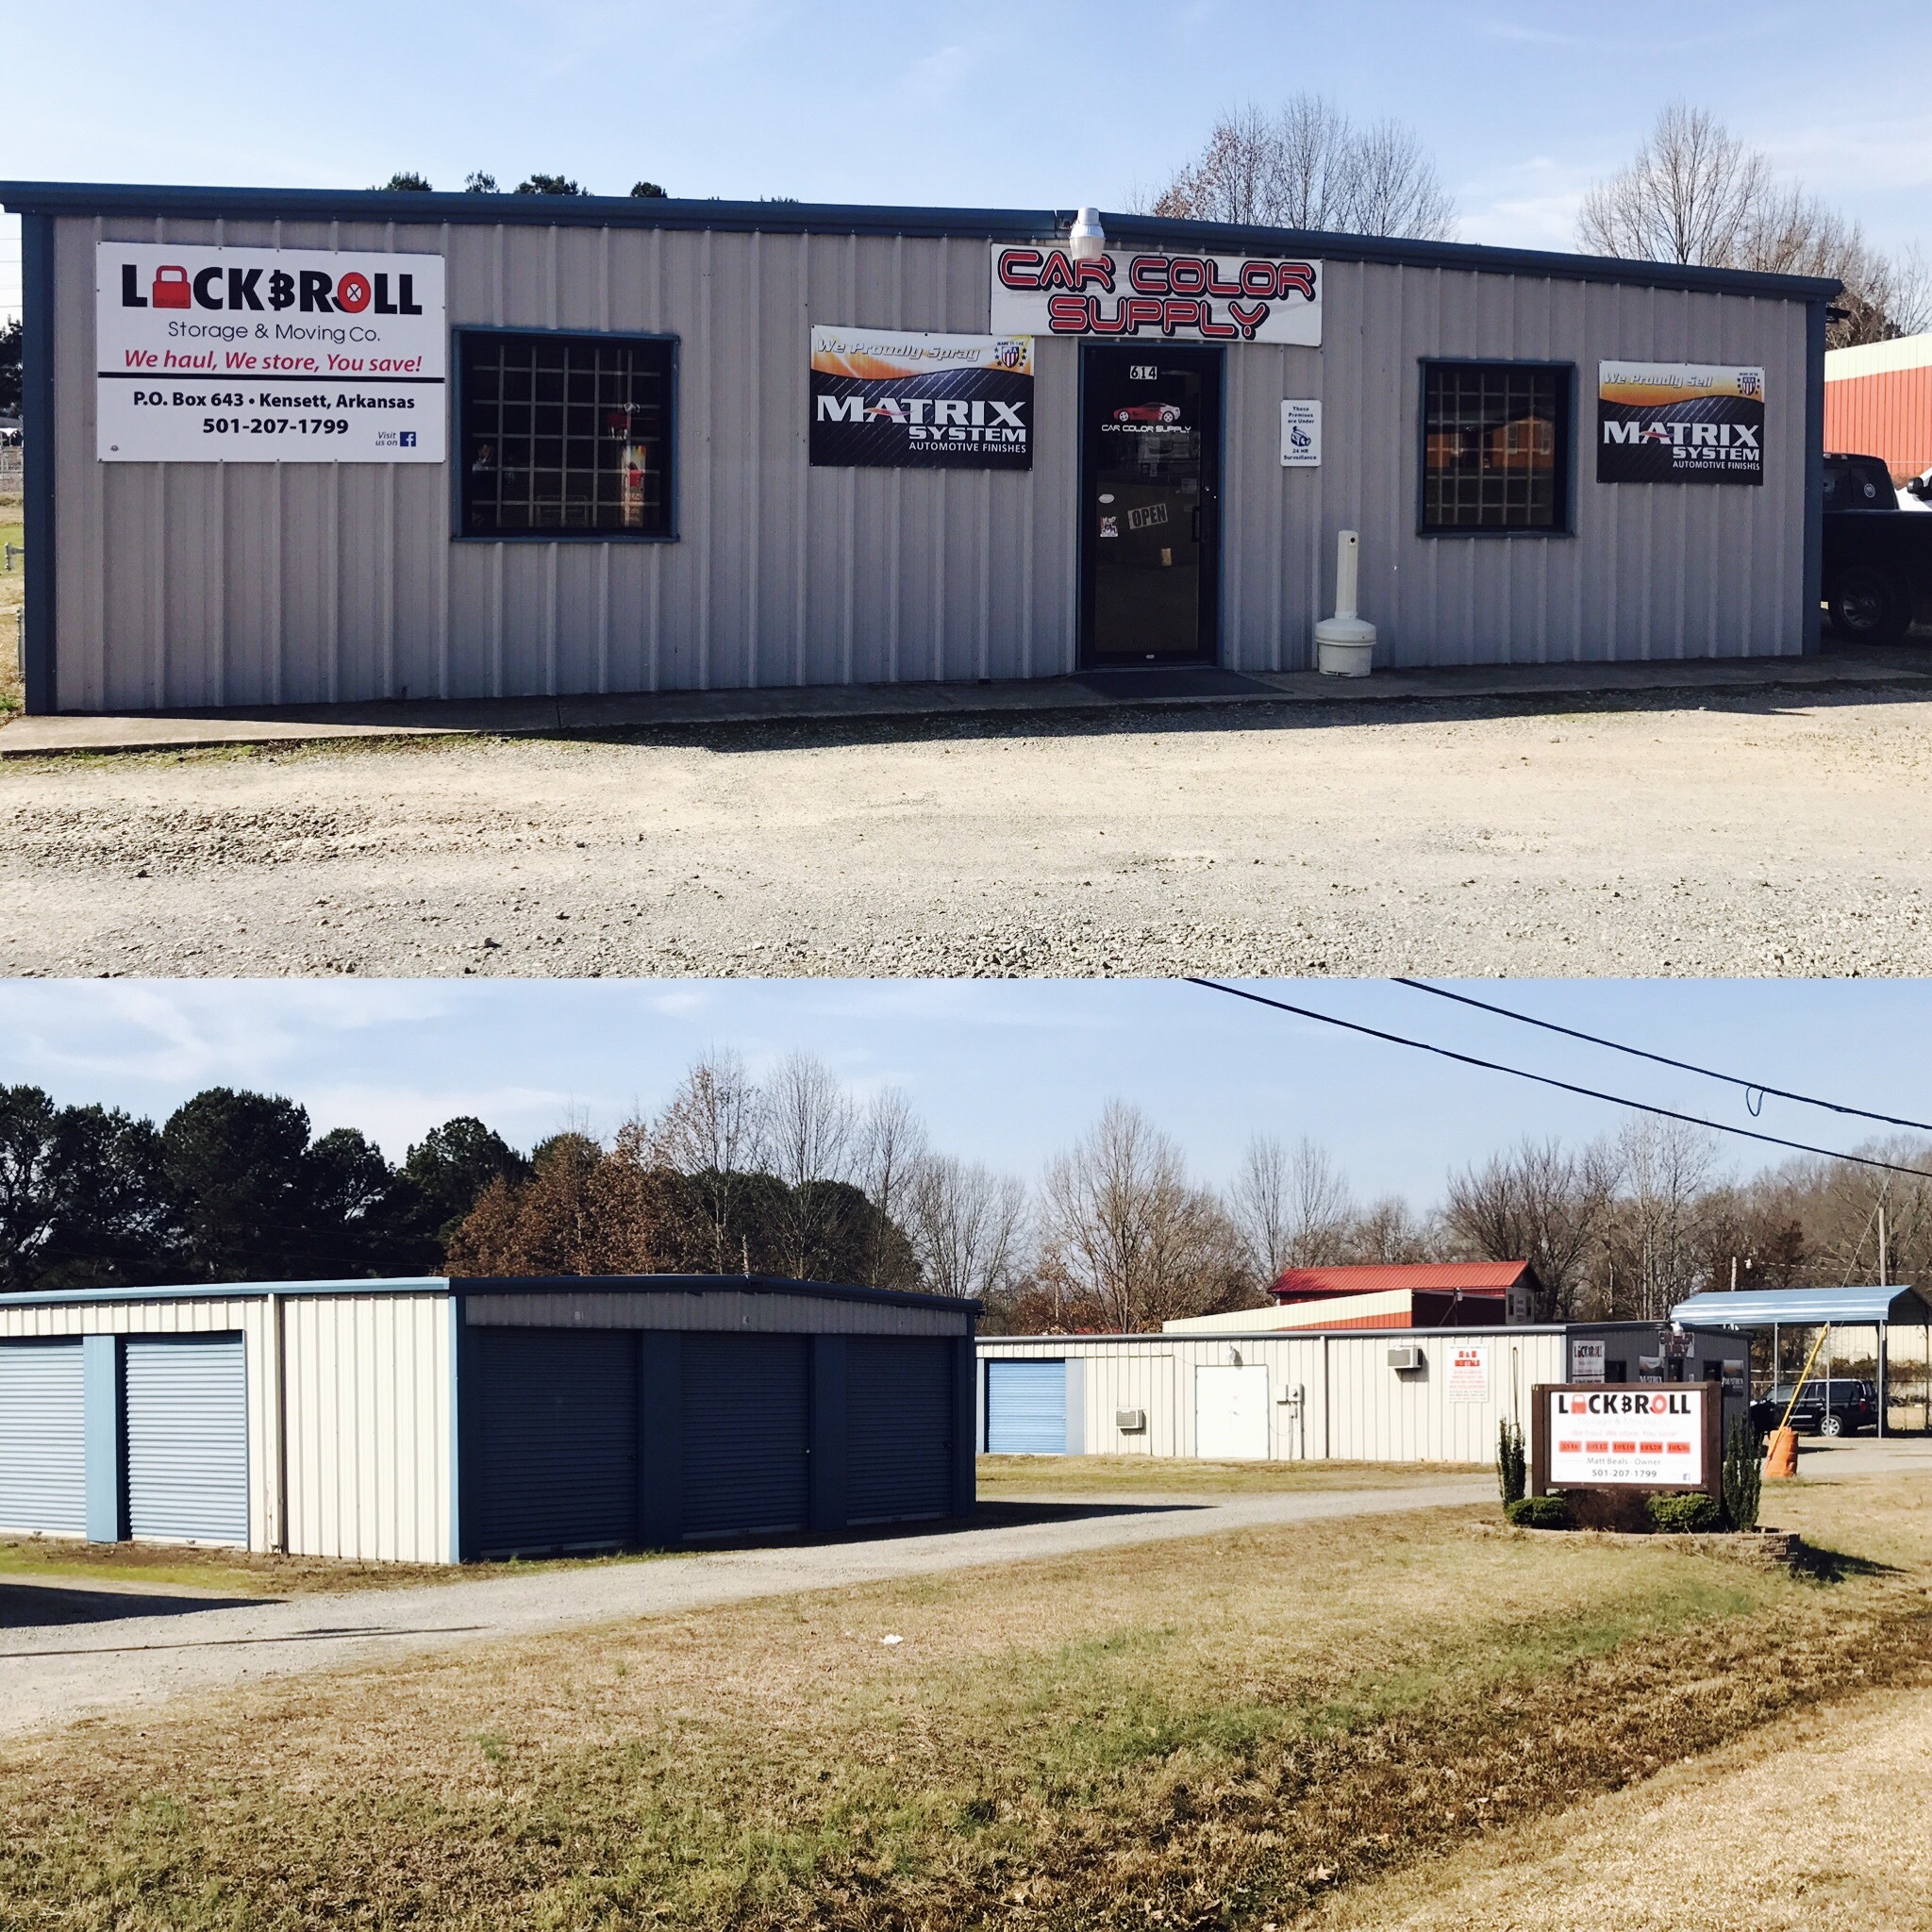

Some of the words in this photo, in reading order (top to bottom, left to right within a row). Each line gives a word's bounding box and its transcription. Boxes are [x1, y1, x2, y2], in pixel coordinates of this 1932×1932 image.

[998, 249, 1116, 293] CAR
[1129, 255, 1316, 301] COLOR
[1047, 293, 1270, 340] SUPPLY
[168, 321, 248, 341] Storage
[255, 324, 269, 339] &
[276, 324, 345, 344] Moving
[349, 326, 380, 342] Co.
[818, 339, 846, 354] We
[850, 342, 924, 360] Proudly
[928, 346, 980, 362] Spray
[125, 349, 158, 367] We
[163, 350, 217, 371] haul,
[225, 352, 257, 370] We
[264, 354, 320, 373] store,
[326, 354, 364, 372] You
[369, 355, 422, 373] save!
[1131, 366, 1156, 378] 614
[1606, 374, 1626, 384] We
[1629, 375, 1683, 388] Proudly
[1686, 376, 1713, 388] Sell
[133, 391, 168, 407] P.O.
[173, 391, 207, 407] Box
[210, 392, 244, 407] 643
[259, 392, 331, 410] Kensett,
[336, 394, 415, 408] Arkansas
[816, 394, 1026, 427] MATRIX
[202, 418, 349, 434] 501-207-1799
[908, 425, 1026, 442] SYSTEM
[1123, 425, 1154, 433] COLOR
[1156, 425, 1191, 434] SUPPLY
[1604, 421, 1759, 448] MATRIX
[377, 431, 396, 440] Visit
[908, 441, 979, 452] AUTOMOTIVE
[982, 443, 1026, 454] FINISHES
[1673, 446, 1759, 461] SYSTEM
[1673, 460, 1725, 470] AUTOMOTIVE
[1727, 461, 1760, 471] FINISHES
[1131, 504, 1167, 528] OPEN
